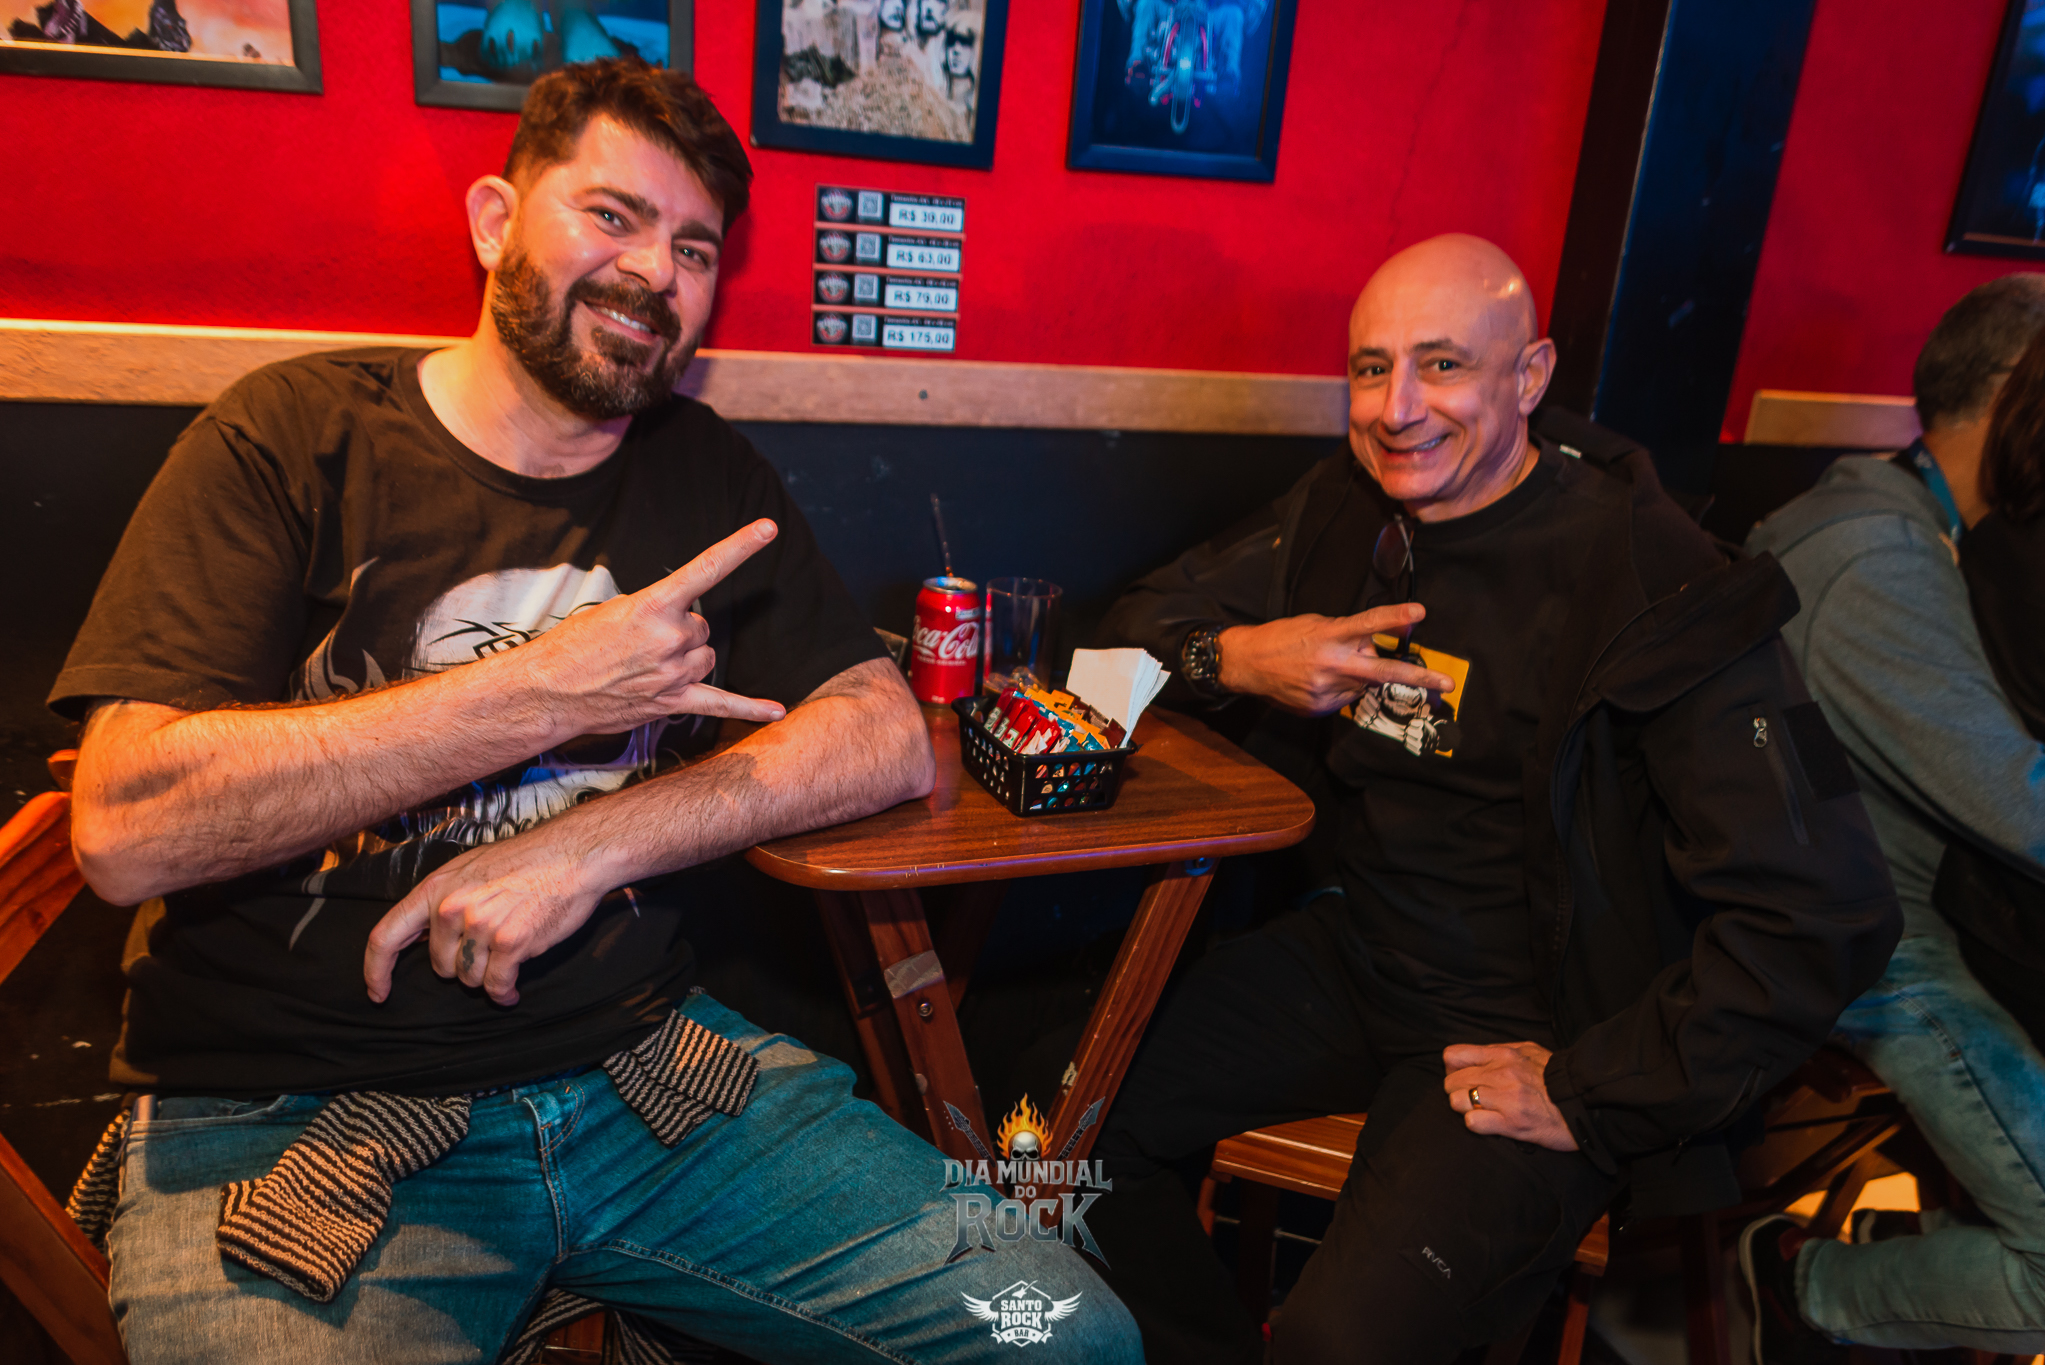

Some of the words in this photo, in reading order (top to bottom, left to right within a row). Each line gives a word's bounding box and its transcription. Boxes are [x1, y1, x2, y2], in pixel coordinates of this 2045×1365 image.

[898, 209, 916, 221] R$
[896, 249, 913, 262] R$
[917, 252, 951, 266] 63,00
[893, 290, 911, 302] R$
[916, 293, 949, 306] 79,00
[887, 330, 904, 342] R$
[909, 332, 950, 345] 175,00
[1421, 1246, 1451, 1279] RVCA
